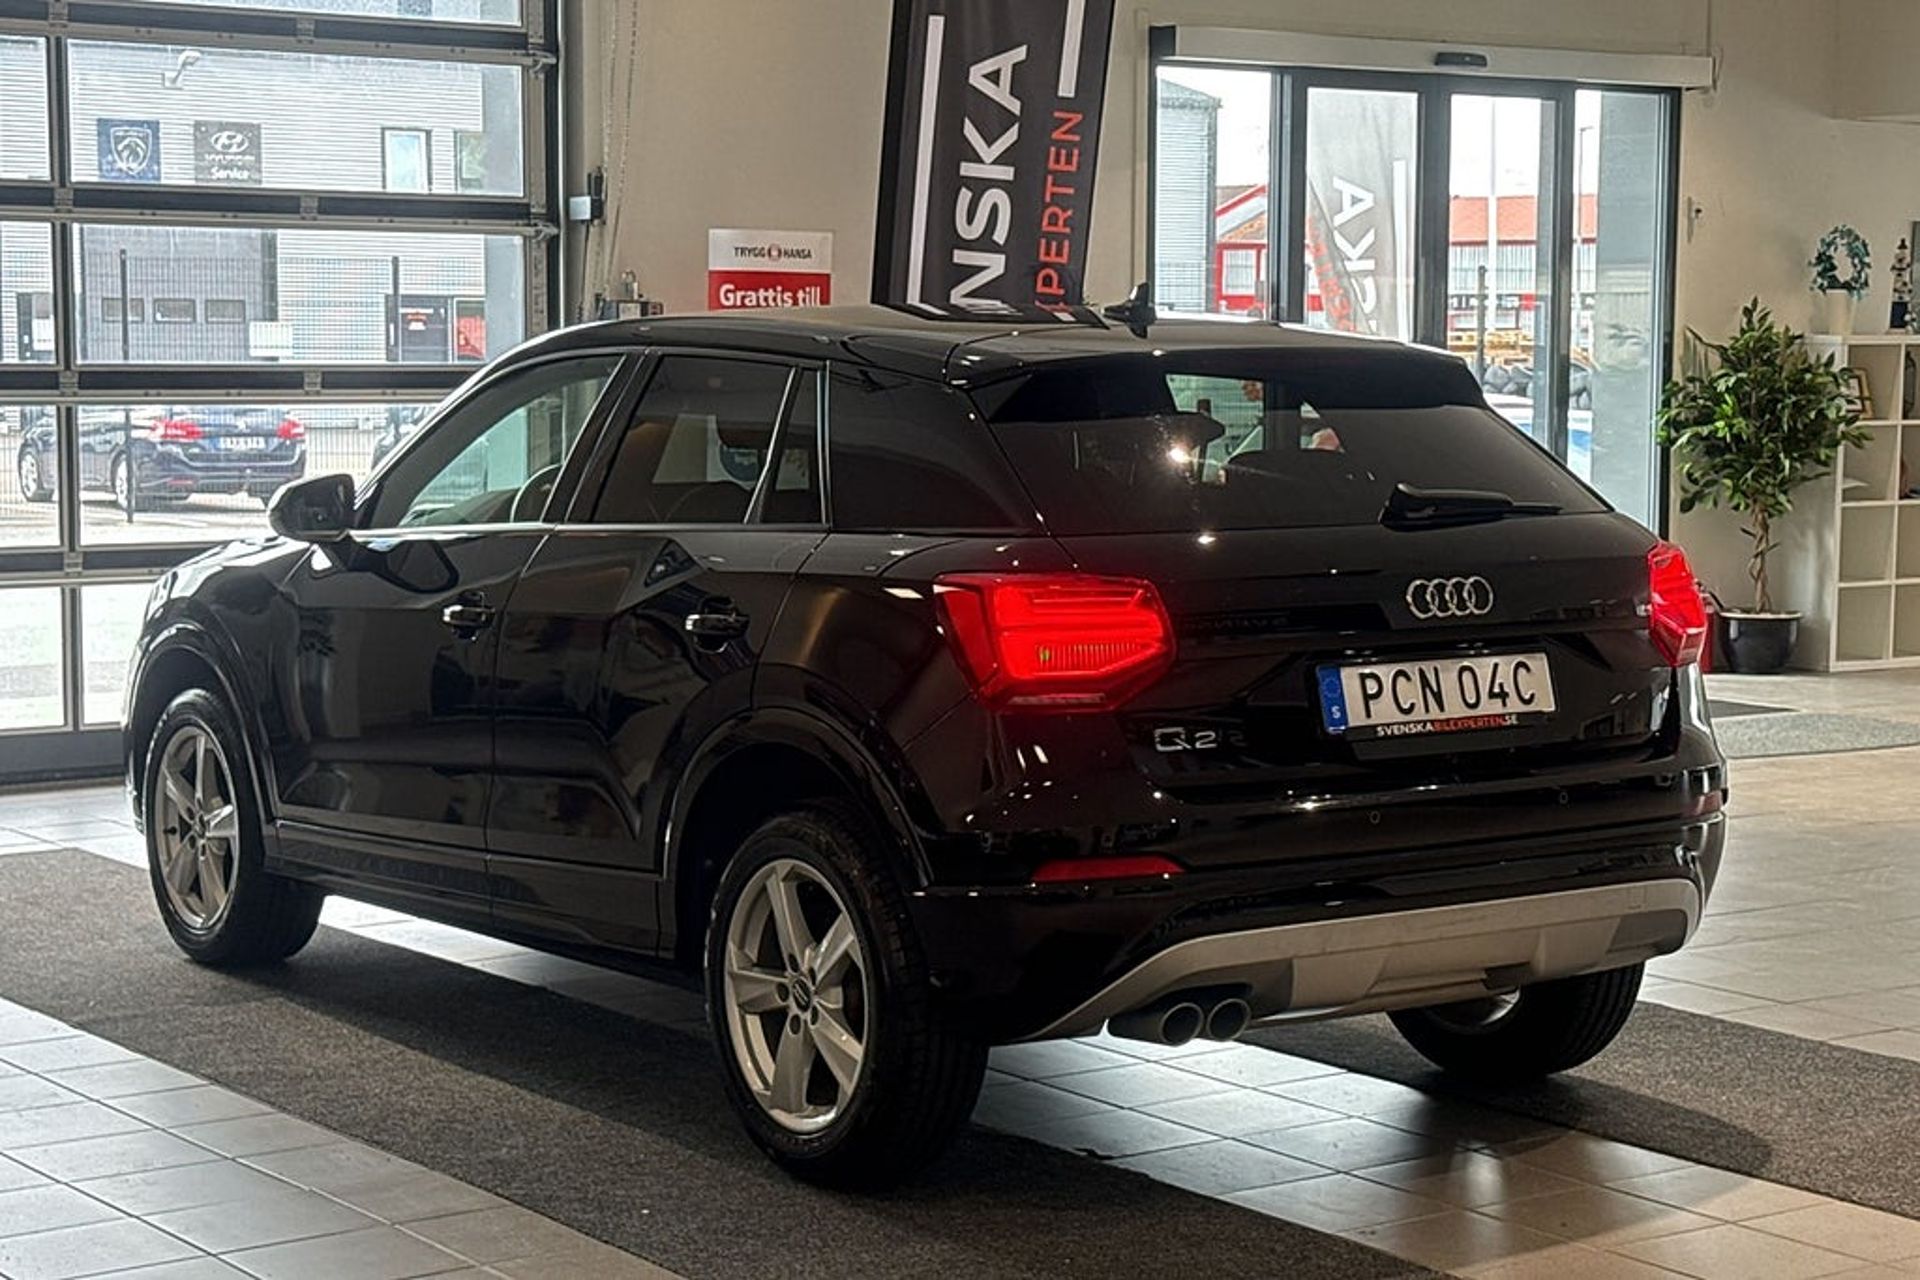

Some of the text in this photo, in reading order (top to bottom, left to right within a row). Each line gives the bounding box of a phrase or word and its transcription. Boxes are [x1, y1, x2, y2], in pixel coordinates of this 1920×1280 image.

[733, 246, 813, 259] TRYGG HANSA
[719, 283, 821, 307] Grattis till
[1357, 660, 1536, 719] PCN 04C
[1331, 705, 1342, 719] S
[1153, 727, 1218, 752] Q2
